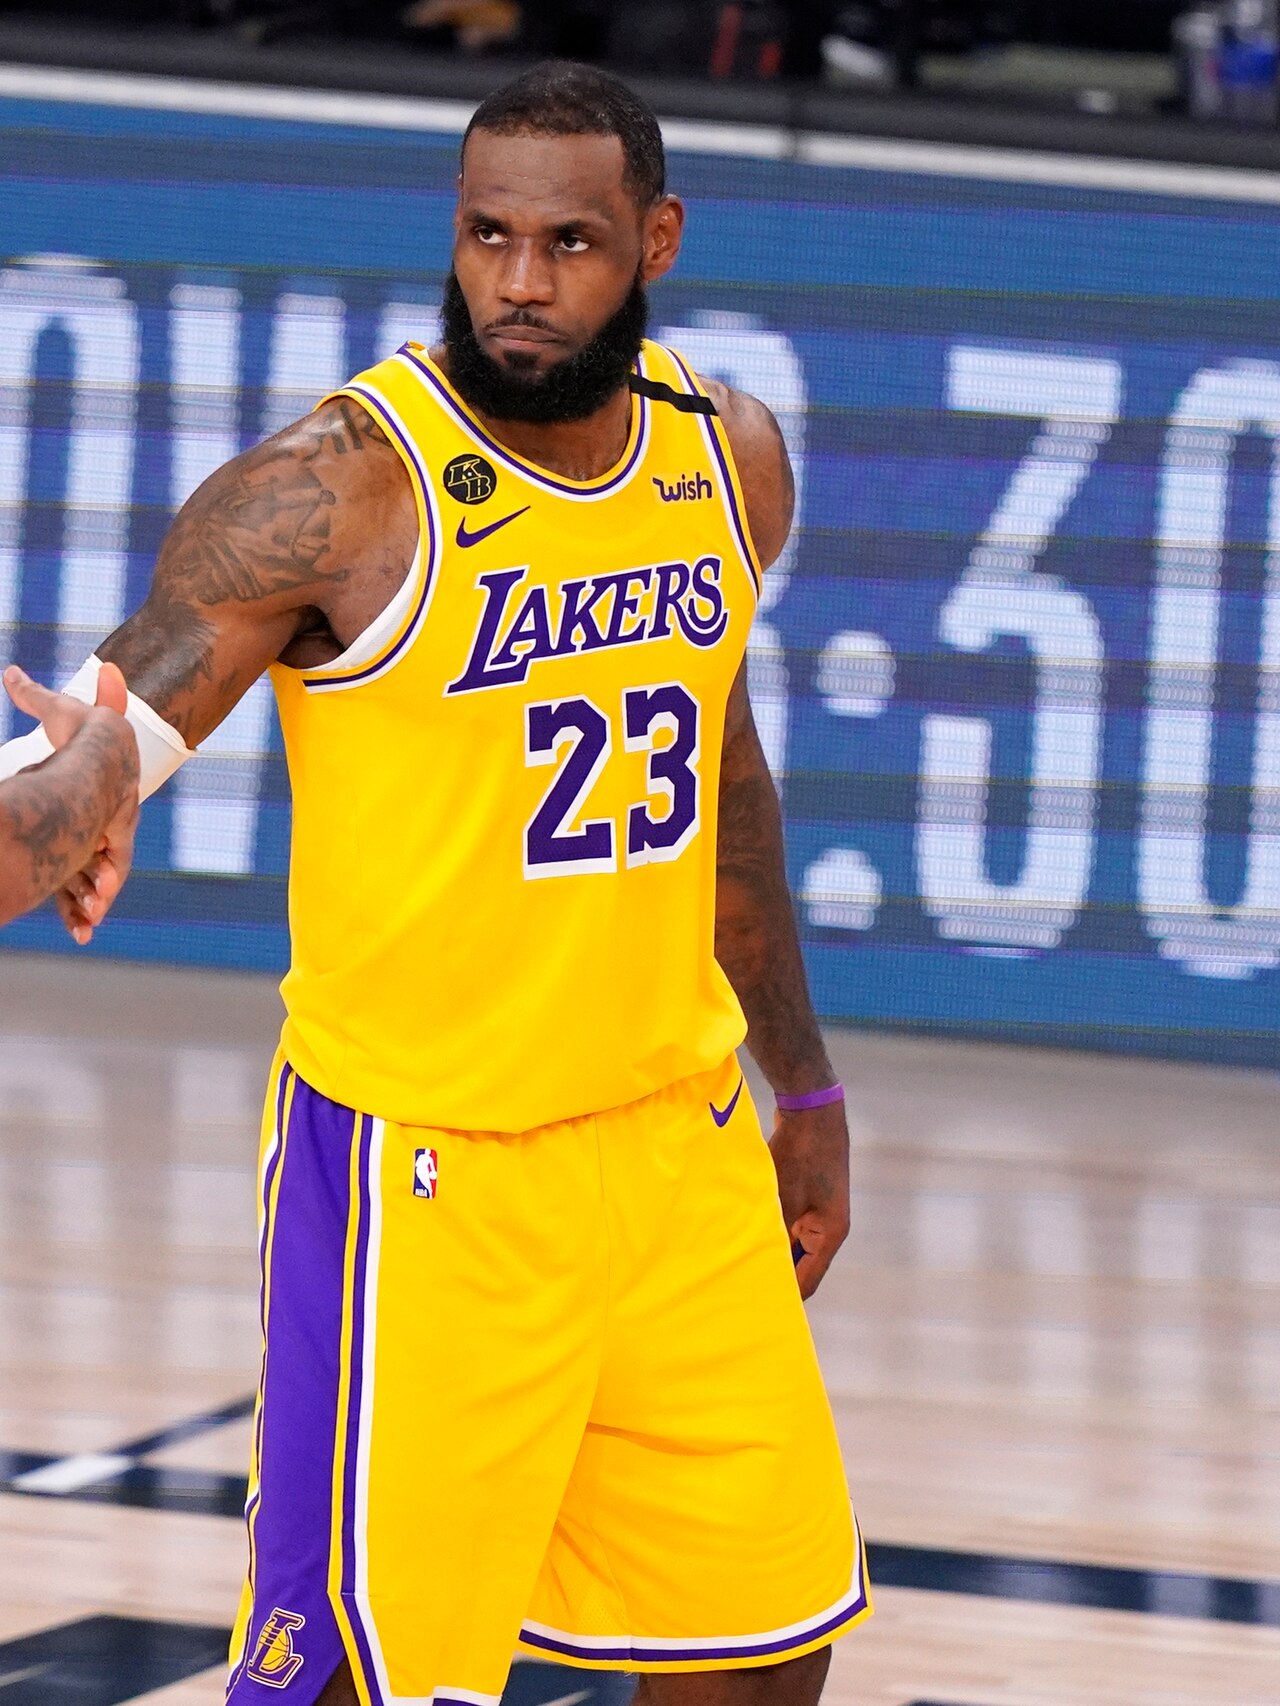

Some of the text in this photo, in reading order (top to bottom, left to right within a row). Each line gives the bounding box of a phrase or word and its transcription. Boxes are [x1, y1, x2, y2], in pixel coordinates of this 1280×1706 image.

[652, 471, 713, 502] wish
[442, 554, 730, 698] LAKERS
[523, 680, 701, 881] 23
